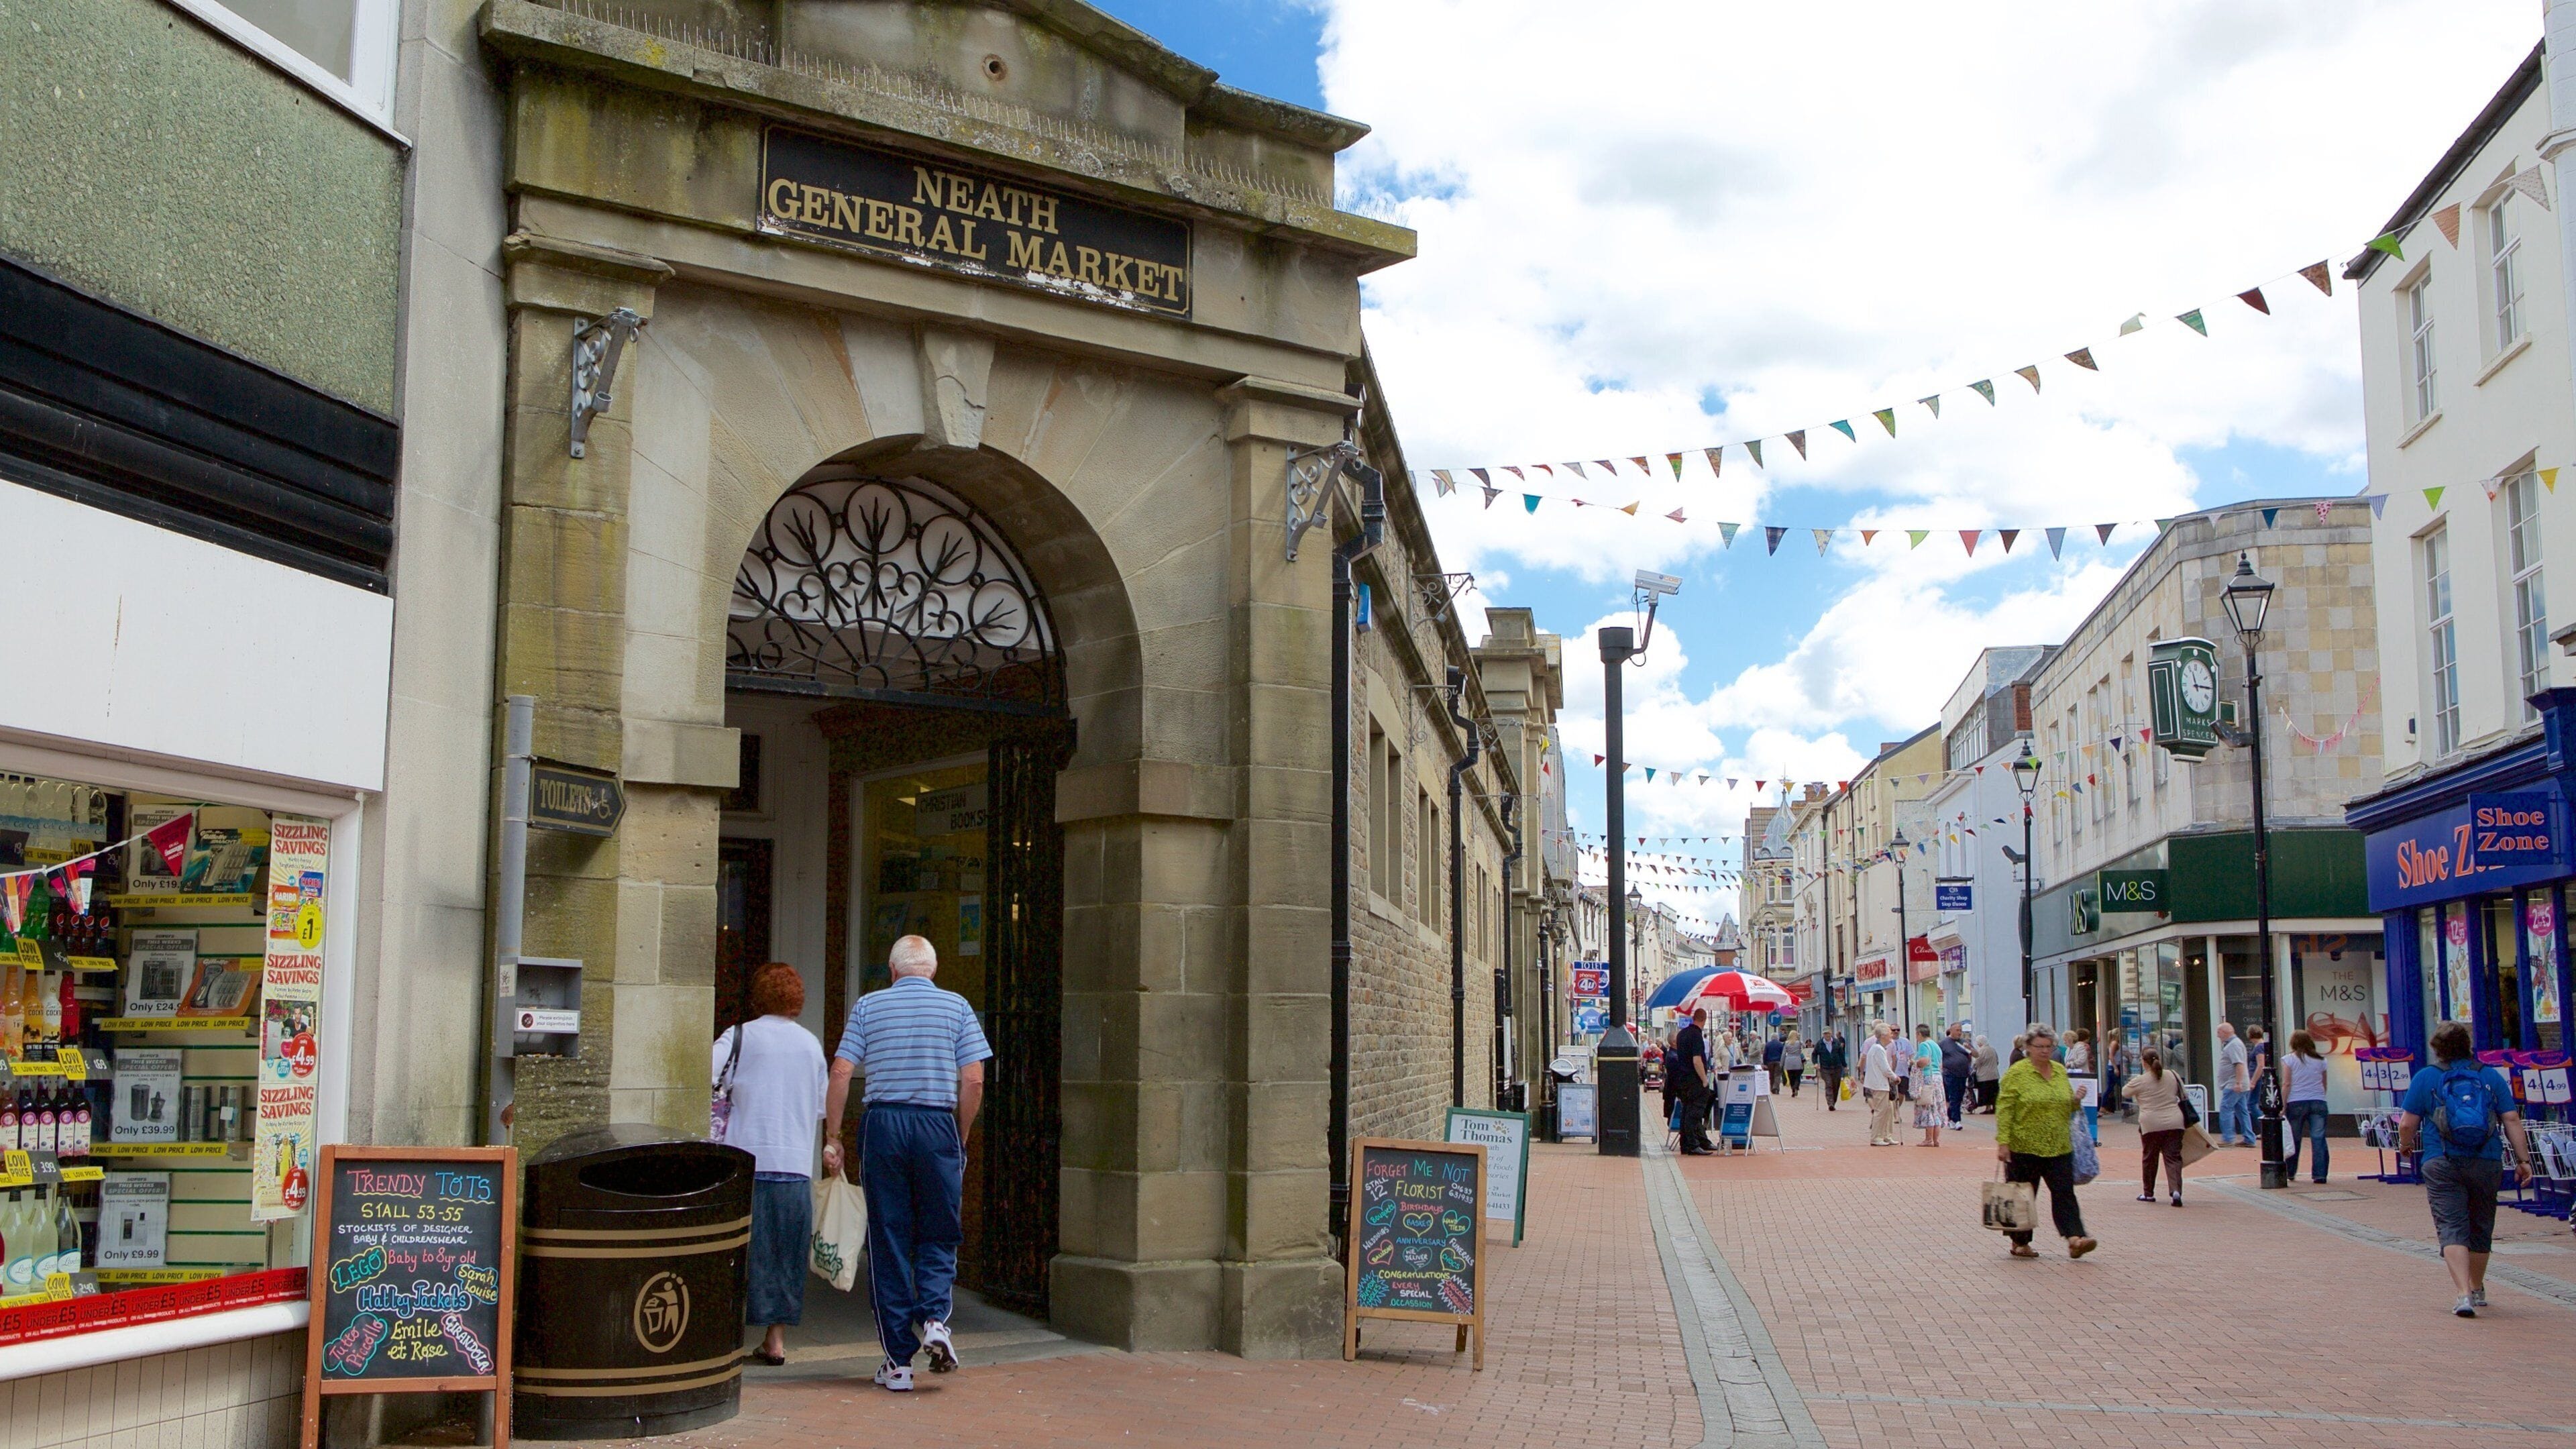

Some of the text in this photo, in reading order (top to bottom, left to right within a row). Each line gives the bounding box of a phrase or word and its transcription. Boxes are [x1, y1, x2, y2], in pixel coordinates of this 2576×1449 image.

[912, 166, 1059, 235] NEATH
[768, 178, 1183, 302] GENERAL MARKET
[2186, 717, 2210, 727] MARKS
[540, 778, 592, 815] TOILETS
[2477, 808, 2544, 827] Shoe
[274, 823, 328, 841] SIZZLING
[275, 839, 326, 856] SAVINGS
[2477, 832, 2549, 851] Zone
[2397, 839, 2449, 889] Shoe
[133, 879, 182, 890] Only £19.
[301, 879, 321, 888] HARIBO
[2106, 881, 2155, 901] M&S
[274, 892, 297, 902] HARIBO
[2068, 889, 2087, 935] M&S
[303, 918, 313, 941] £1
[18, 941, 37, 954] LOW
[22, 954, 42, 964] PRICE
[267, 954, 321, 969] SIZZLING
[267, 970, 319, 985] SAVINGS
[2332, 971, 2354, 980] THE
[2320, 985, 2366, 1002] M&S
[129, 1003, 154, 1012] Only
[60, 1052, 79, 1065] LOW
[292, 1045, 315, 1066] £4.99
[65, 1065, 84, 1074] PRICE
[2392, 1070, 2409, 1080] 2.99
[2546, 1079, 2567, 1090] 4.99
[260, 1085, 315, 1103] SIZZLING
[260, 1102, 312, 1119] SAVINGS
[115, 1126, 175, 1136] Only £39.99
[1460, 1118, 1489, 1131] Tom
[1460, 1129, 1513, 1144] Thomas
[7, 1151, 26, 1167] LOW
[40, 1161, 56, 1173] 3.99
[1496, 1155, 1504, 1163] of
[9, 1167, 31, 1177] PRICE
[1366, 1159, 1471, 1183] FORGET ME NOT
[284, 1178, 306, 1199] £4.99
[347, 1169, 492, 1200] TRENDY TOTS
[1364, 1177, 1389, 1191] STALL
[1395, 1180, 1446, 1199] FLORIST
[1450, 1183, 1473, 1195] 01639
[1370, 1184, 1389, 1201] 12
[1448, 1190, 1474, 1205] 631933
[361, 1202, 410, 1218] STALL
[1399, 1201, 1444, 1216] BIRTHDAYS
[338, 1224, 473, 1234] STOCKISTS OF DESIGNER
[354, 1233, 468, 1246] BABY & CHILDRENSWEAR
[1362, 1226, 1390, 1251] WEDDINGS
[1395, 1236, 1446, 1247] ANNIVERSARY
[104, 1249, 159, 1261] Only £9.99
[388, 1246, 476, 1273] Baby to 8yr old
[1405, 1253, 1428, 1262] DELIVER
[1448, 1238, 1475, 1267] FUNERALS
[336, 1248, 382, 1287] LEGO
[1441, 1252, 1460, 1270] CHOCS
[458, 1264, 495, 1286] Sarah
[1379, 1269, 1451, 1280] CONGRATULATIONS
[464, 1279, 497, 1301] Louise
[1392, 1281, 1420, 1291] EVERY
[361, 1285, 467, 1316] Hatley Jackets
[1391, 1298, 1433, 1307] OCCASSION
[25, 1305, 76, 1329] UNDER £5
[80, 1298, 127, 1320] UNDER £5
[390, 1318, 443, 1340] Emile
[329, 1325, 360, 1361] Tutto
[387, 1340, 449, 1361] et Rose
[445, 1314, 490, 1372] GIRANDOLA
